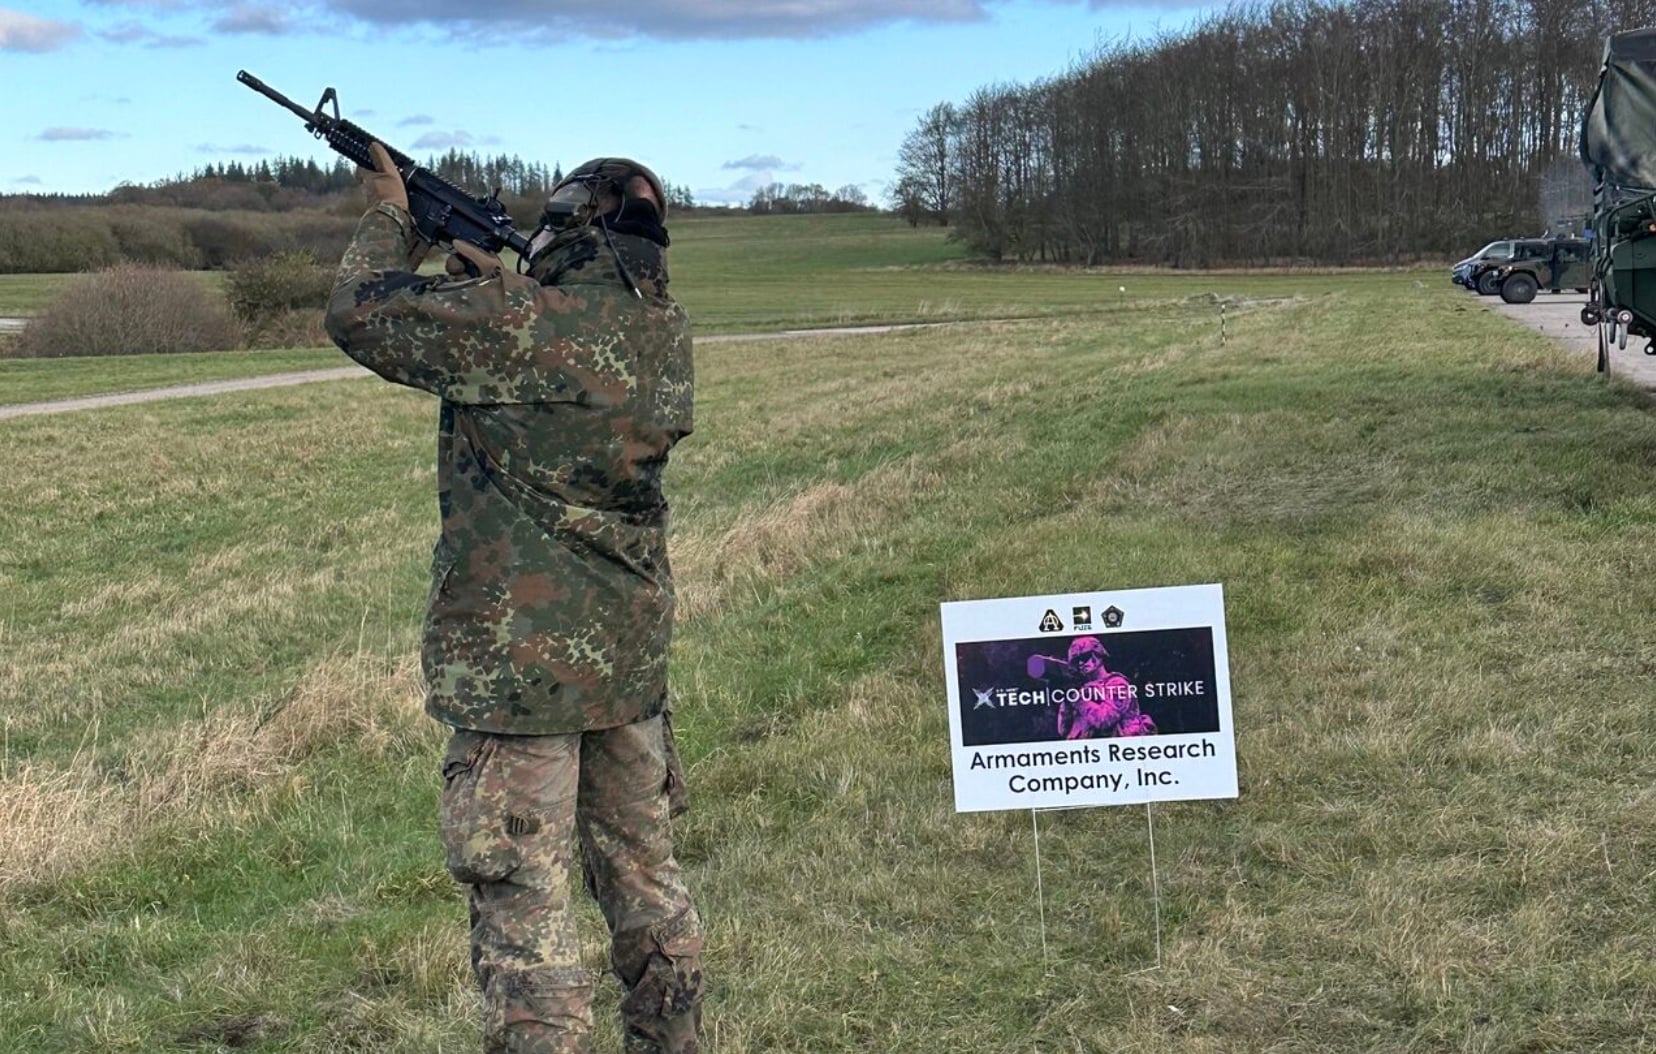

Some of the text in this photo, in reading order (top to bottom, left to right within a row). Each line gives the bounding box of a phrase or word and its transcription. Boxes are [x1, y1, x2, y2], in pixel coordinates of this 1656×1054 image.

[1051, 685, 1138, 703] COUNTER
[1145, 680, 1205, 698] STRIKE
[970, 739, 1216, 770] Armaments Research
[1009, 769, 1180, 794] Company, Inc.
